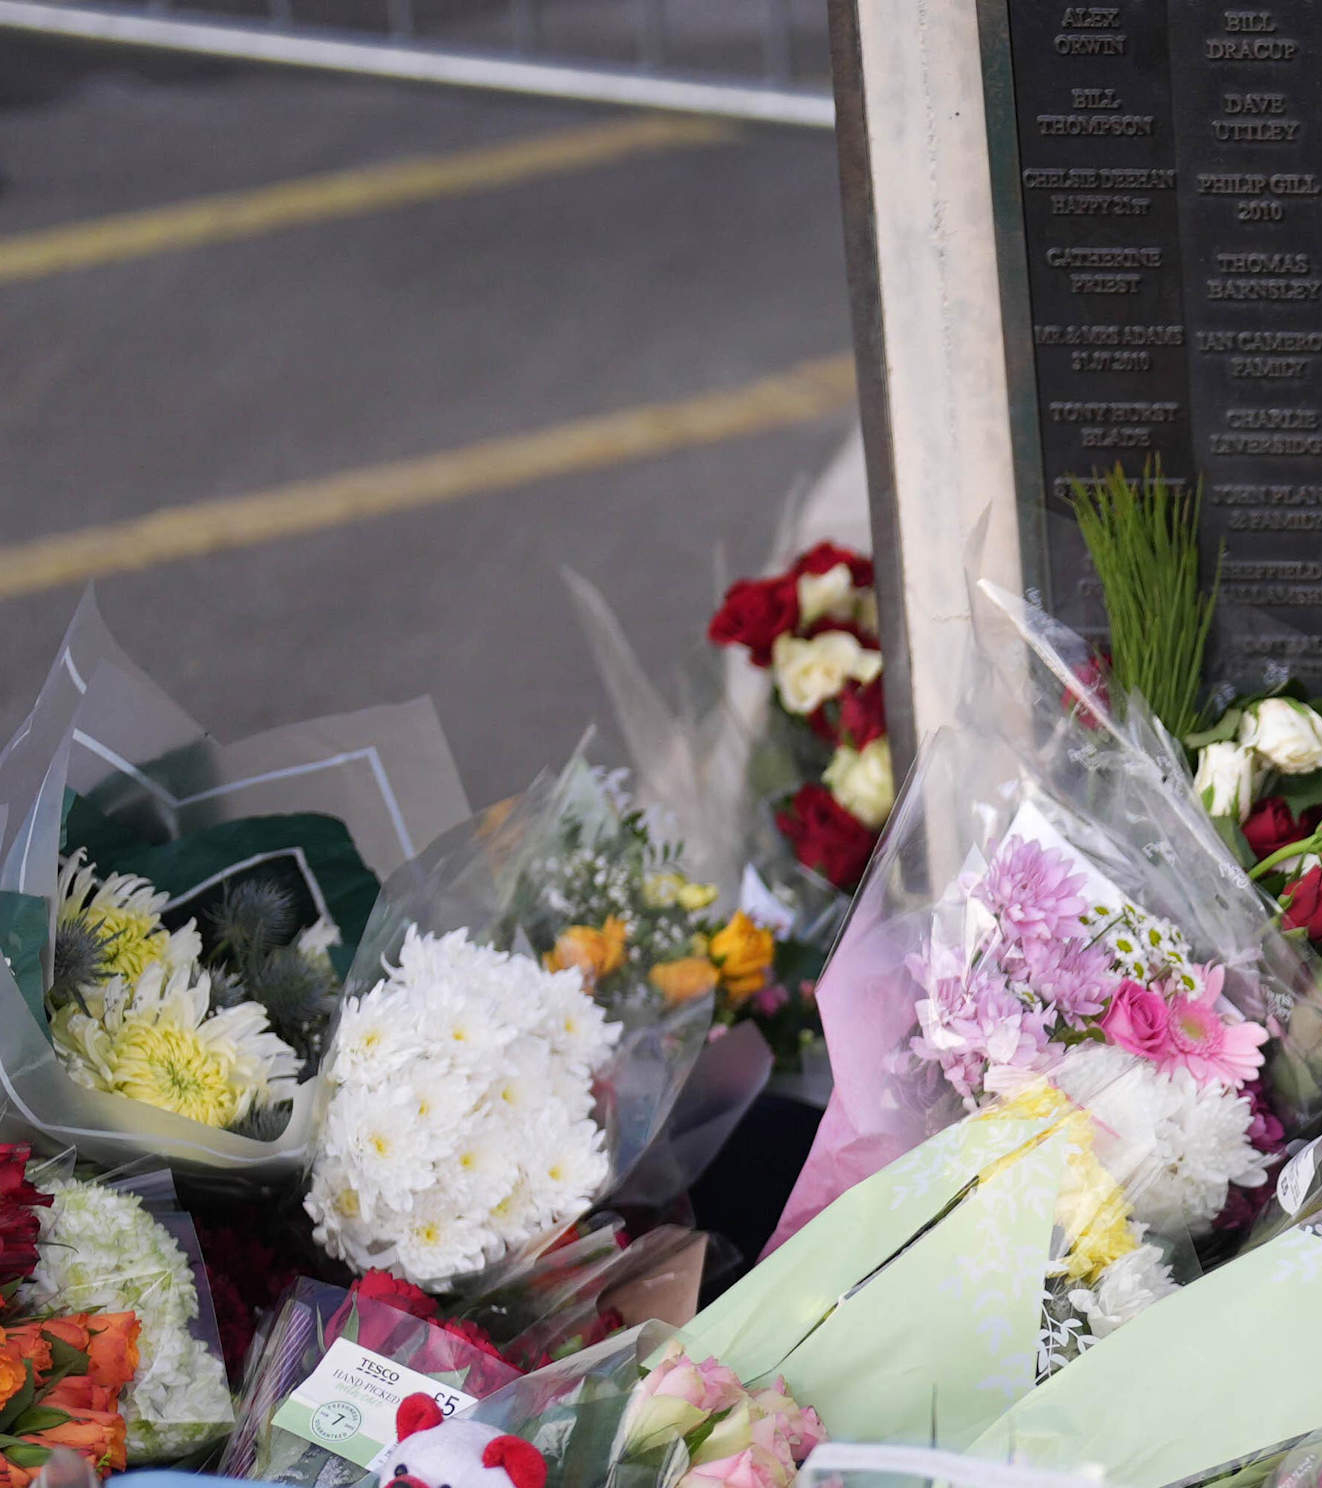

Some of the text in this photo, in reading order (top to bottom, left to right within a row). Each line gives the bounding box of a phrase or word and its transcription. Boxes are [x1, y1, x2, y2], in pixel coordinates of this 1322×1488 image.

[1062, 8, 1120, 28] ALEX
[1225, 13, 1276, 33] BILL
[1055, 35, 1126, 55] ORWIN
[1207, 39, 1297, 60] DRACUP
[1073, 89, 1120, 109] BILL
[1225, 94, 1285, 114] DAVE
[1037, 116, 1154, 135] THOMPSON
[1270, 174, 1320, 194] GILL
[1239, 202, 1284, 222] 2010
[1046, 248, 1161, 268] CATHERINE
[1217, 254, 1308, 274] THOMAS
[1071, 274, 1141, 293] PRIEST
[1207, 280, 1322, 300] BARNSLEY
[360, 1356, 401, 1383] TESCO
